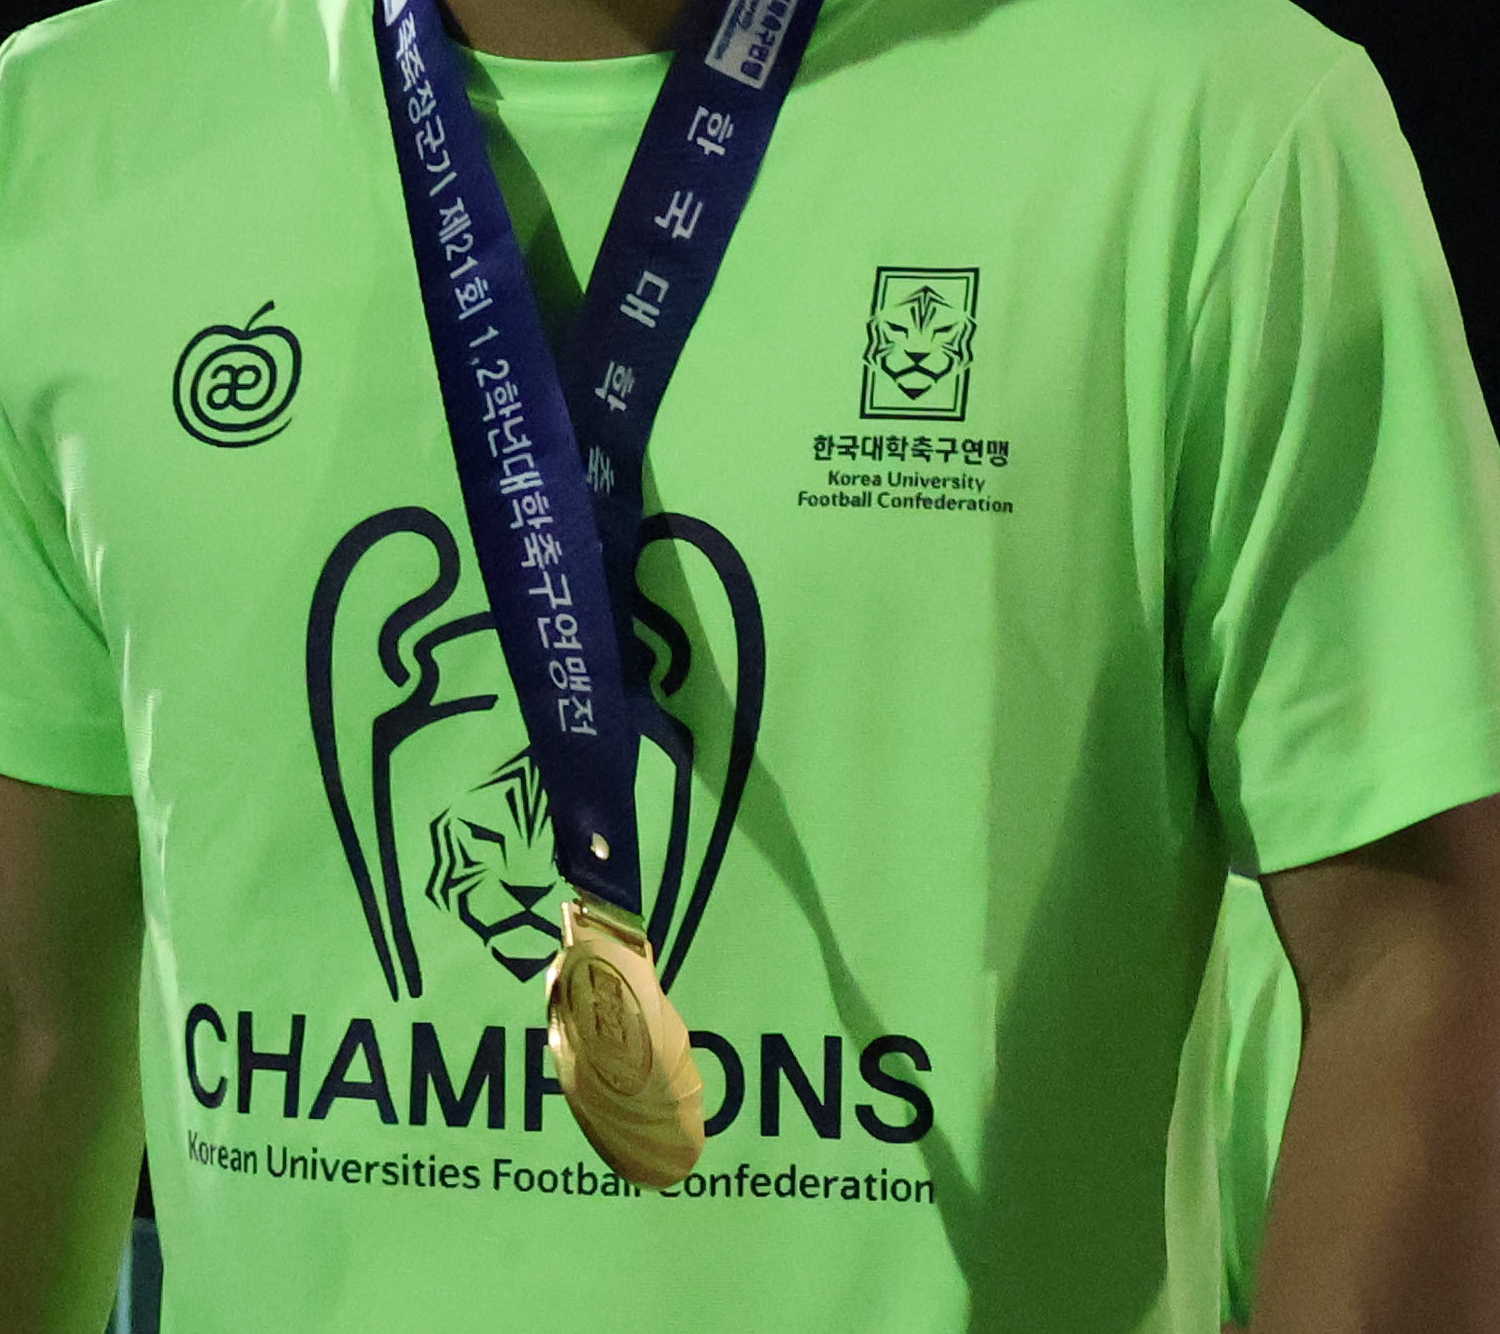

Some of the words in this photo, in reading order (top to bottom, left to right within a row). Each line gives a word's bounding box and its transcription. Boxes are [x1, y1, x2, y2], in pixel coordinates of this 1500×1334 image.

[438, 197, 494, 321] 제21회
[813, 434, 1010, 467] 한국대학축구연맹
[797, 491, 872, 509] Football
[877, 491, 1014, 514] Confederation
[827, 470, 882, 487] Korea
[888, 471, 986, 493] University
[184, 1003, 935, 1145] CHAMPONS
[186, 1129, 259, 1177] Korean
[267, 1145, 481, 1192] Universities
[659, 1162, 936, 1205] onfederation
